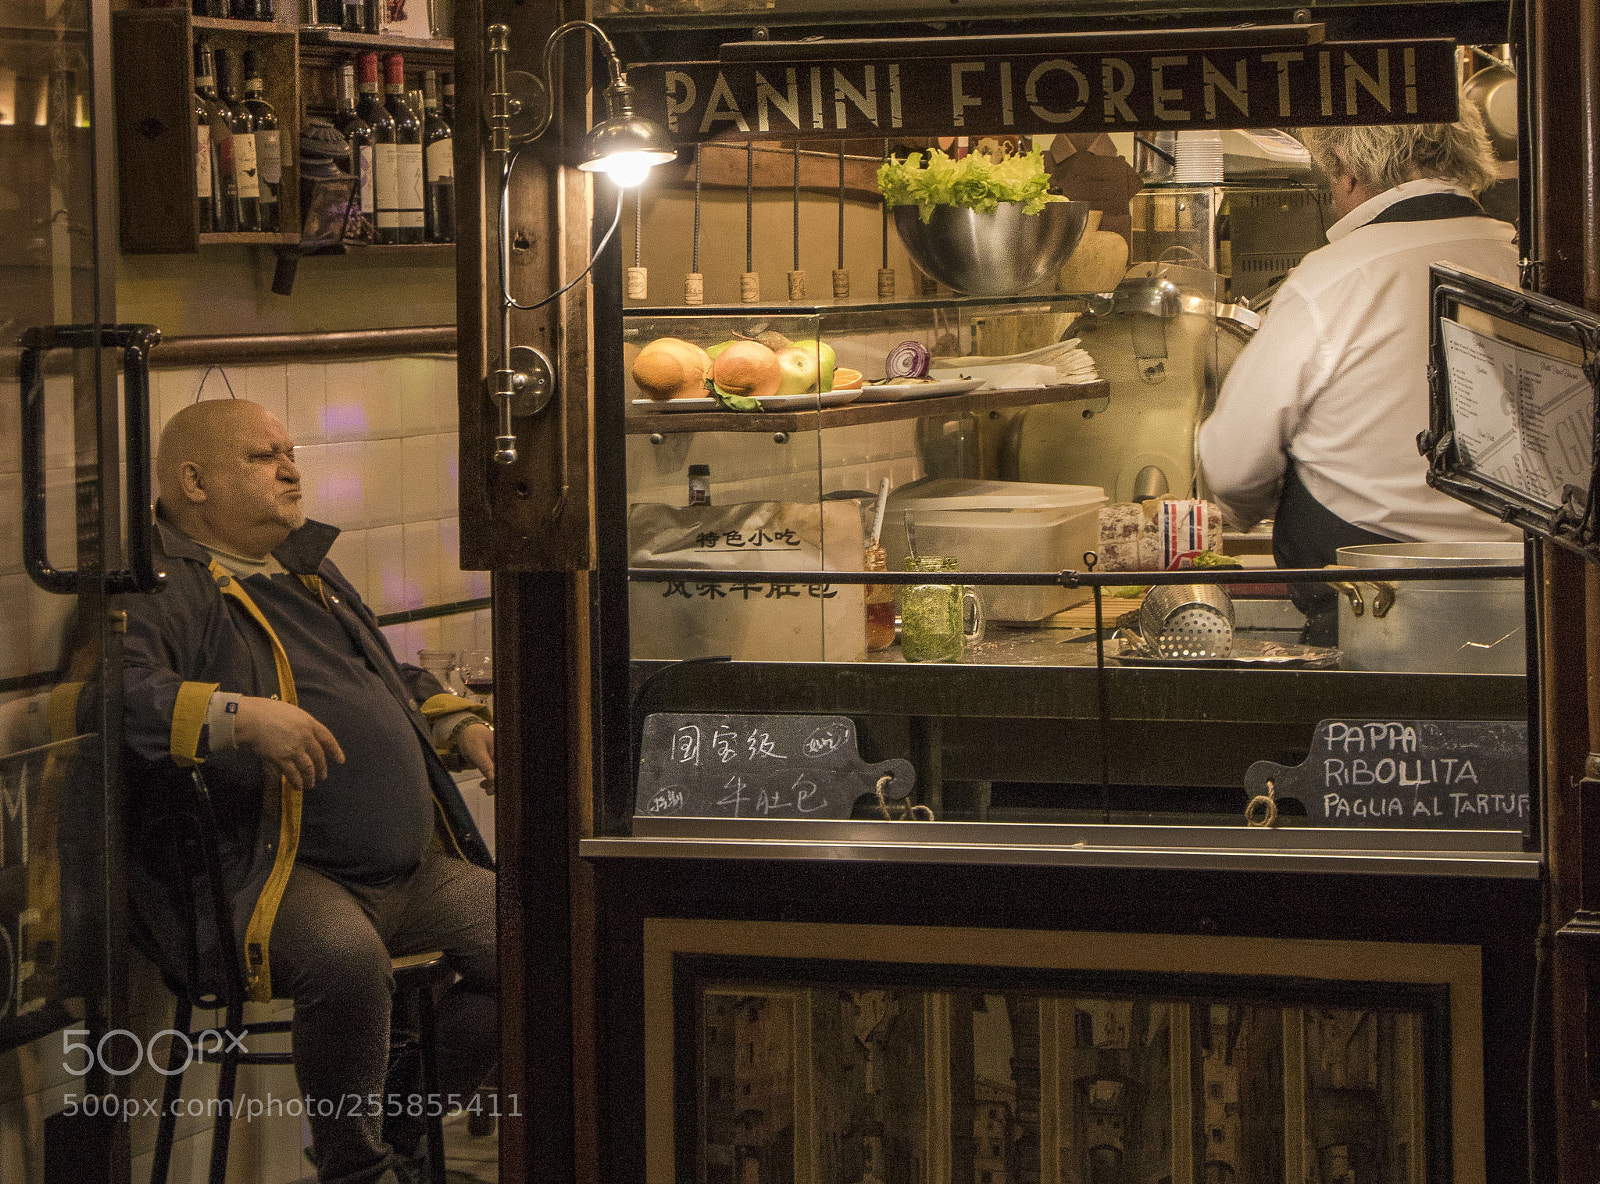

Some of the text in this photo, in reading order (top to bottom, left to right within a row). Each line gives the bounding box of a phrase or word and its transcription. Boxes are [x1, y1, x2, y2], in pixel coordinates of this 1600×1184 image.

[665, 47, 1418, 133] PANINI FIORENTINI
[695, 528, 802, 549] 特色小吃
[1323, 721, 1418, 753] PAPPA
[1323, 792, 1404, 818] PAGLIA
